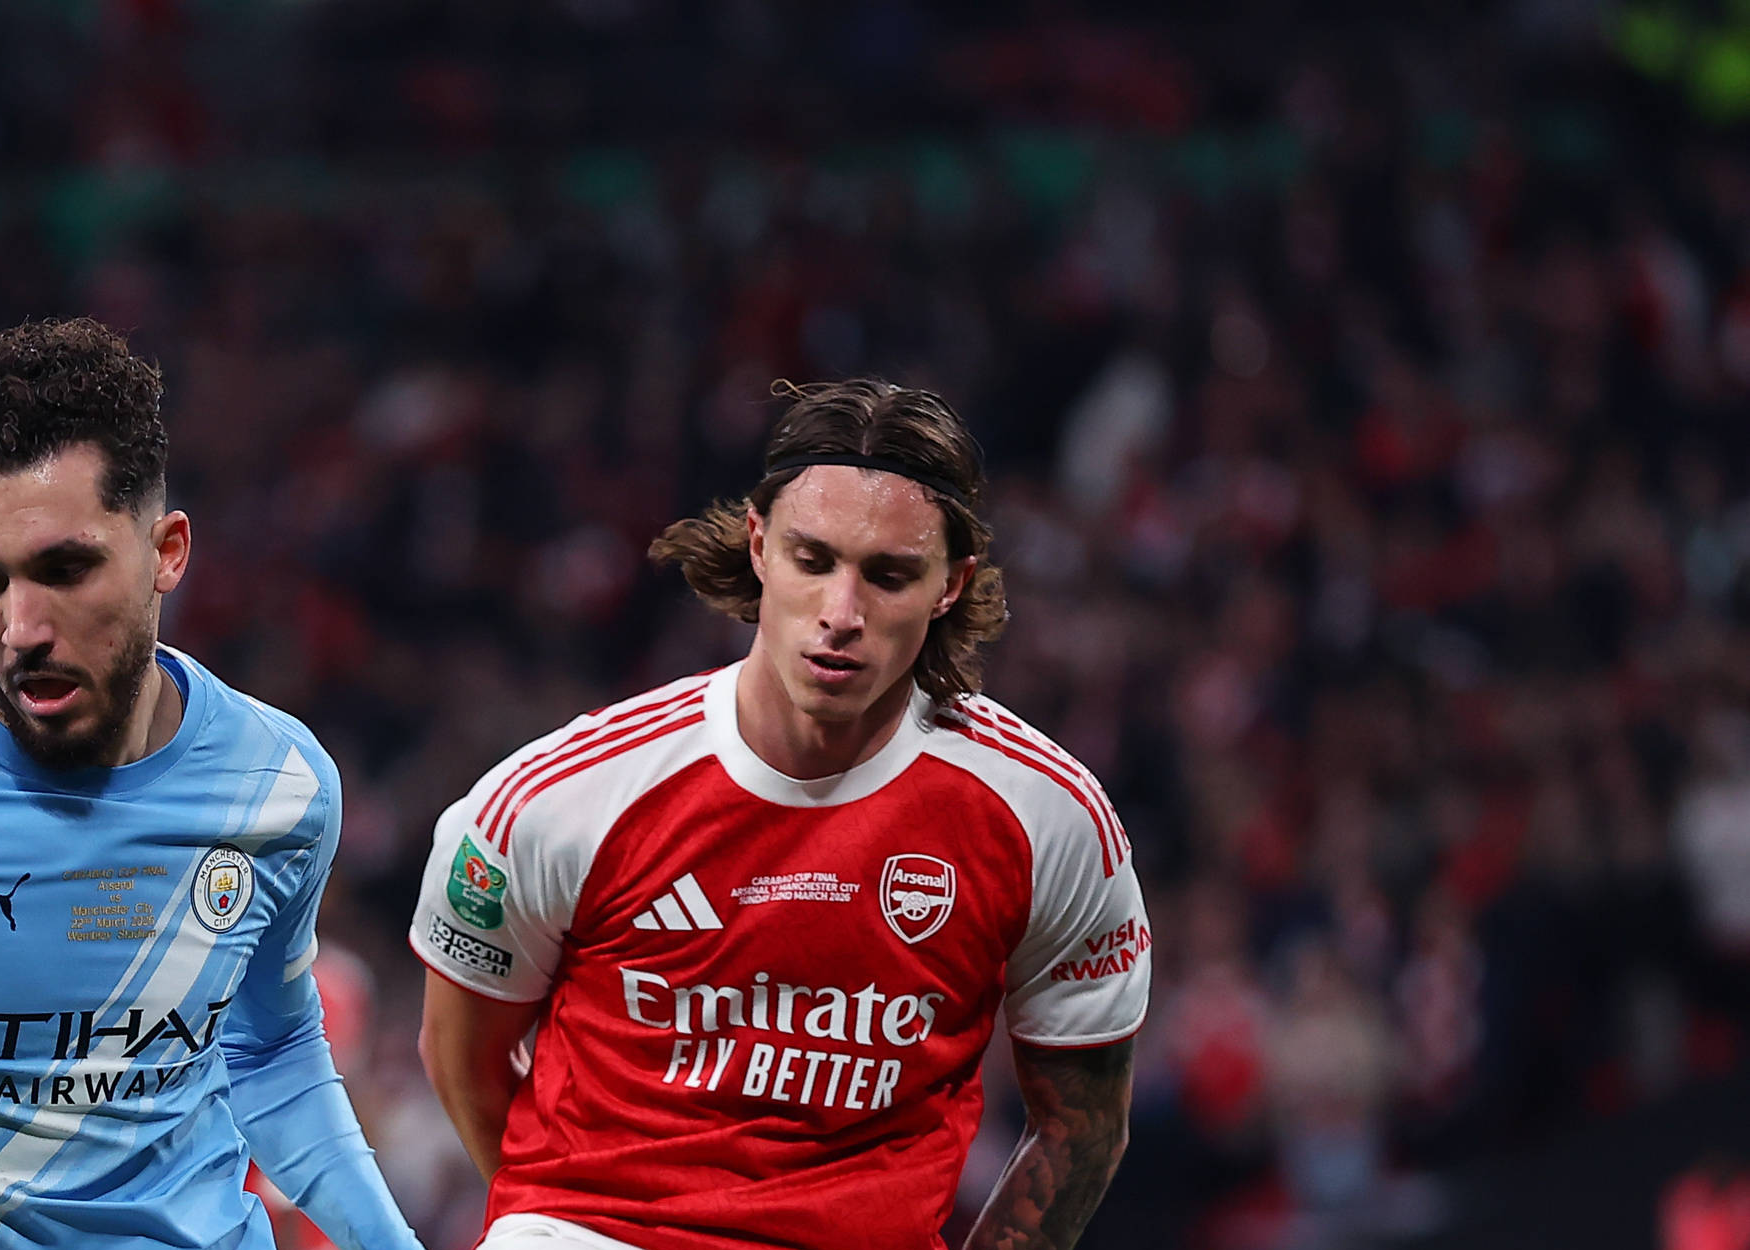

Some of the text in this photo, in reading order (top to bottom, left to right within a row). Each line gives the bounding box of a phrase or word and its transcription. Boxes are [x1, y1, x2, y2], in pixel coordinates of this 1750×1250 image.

[200, 850, 249, 880] MANCHESTER
[98, 880, 135, 891] Arsenal
[751, 872, 839, 885] CARABAO CUP FINAL
[892, 868, 945, 888] Arsenal
[793, 892, 828, 901] MARCH
[839, 883, 861, 893] CITY
[72, 902, 155, 917] Manchester City
[97, 917, 127, 928] March
[214, 917, 231, 927] CITY
[1084, 916, 1136, 955] VISI
[453, 933, 503, 962] room
[1050, 925, 1152, 981] RWANA
[619, 966, 945, 1046] Emirates
[662, 1038, 901, 1110] FLY BETTER
